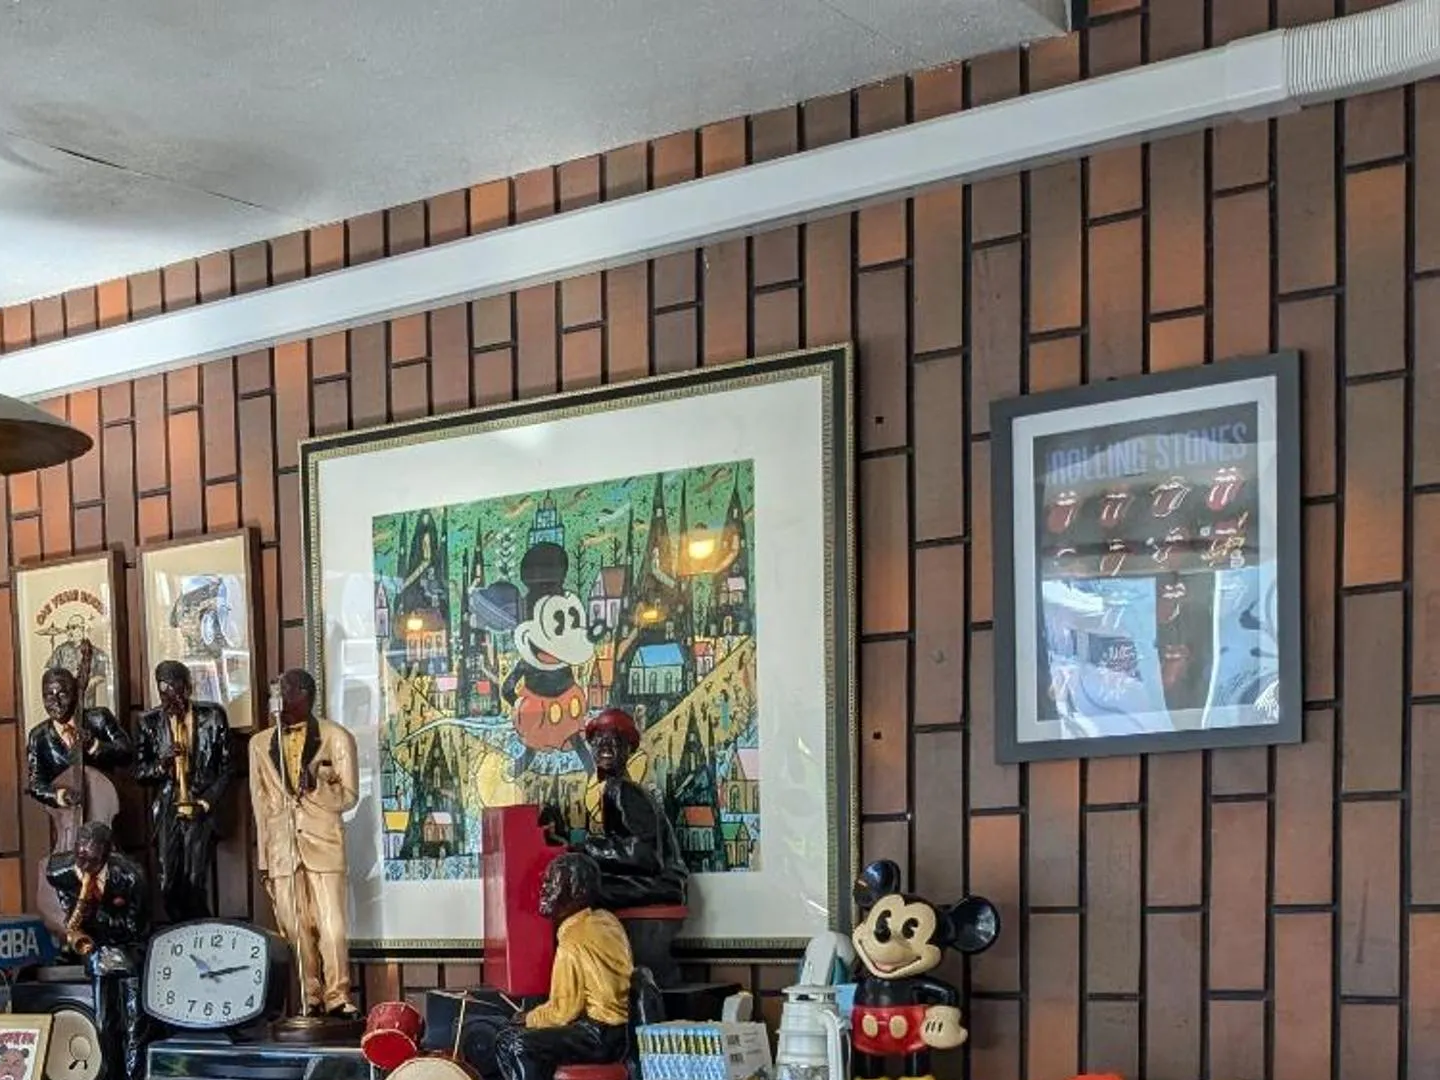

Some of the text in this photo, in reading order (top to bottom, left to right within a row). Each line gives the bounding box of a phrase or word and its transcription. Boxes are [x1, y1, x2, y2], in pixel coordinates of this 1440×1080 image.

[1155, 422, 1247, 470] STONES
[193, 936, 204, 949] 11
[210, 934, 223, 948] 12
[231, 937, 237, 950] 1
[171, 943, 183, 956] 10
[250, 946, 260, 959] 2
[162, 966, 172, 981] 9
[253, 969, 262, 985] 3
[166, 990, 175, 1005] 8
[244, 994, 254, 1009] 4
[187, 1000, 197, 1013] 7
[203, 1002, 213, 1016] 6
[222, 1002, 231, 1016] 5
